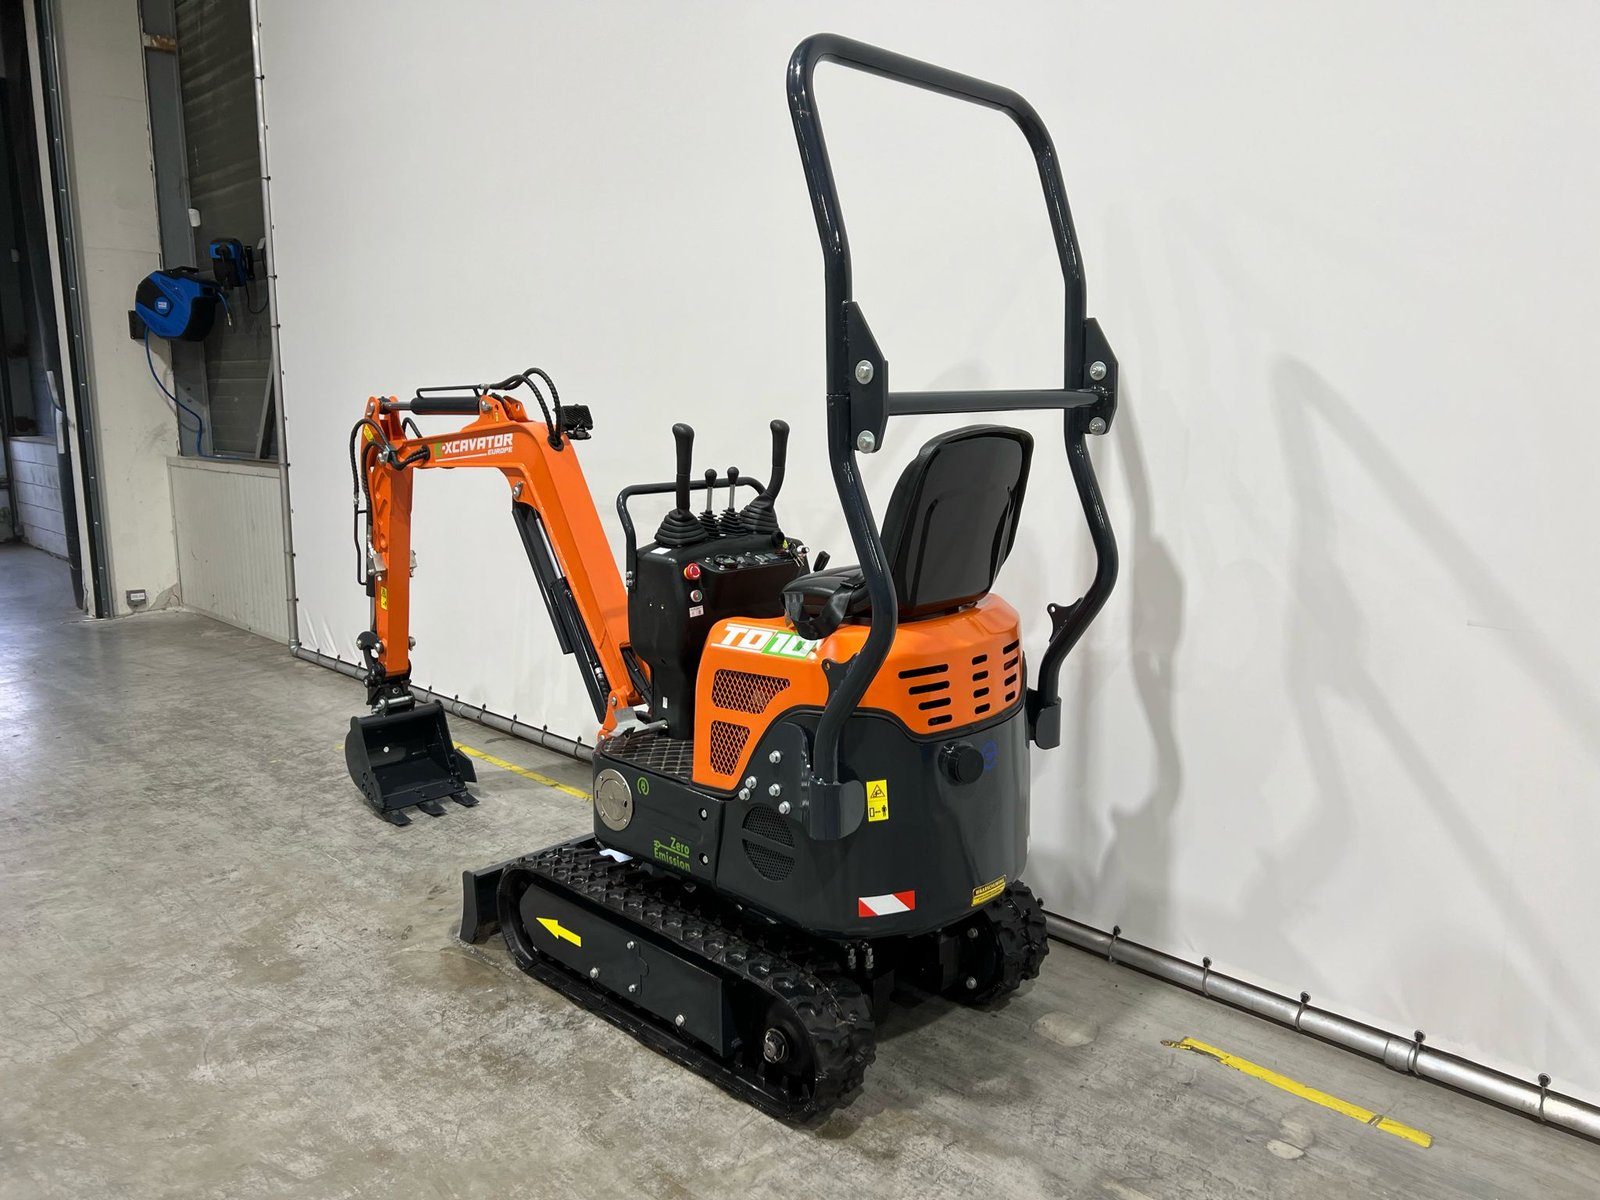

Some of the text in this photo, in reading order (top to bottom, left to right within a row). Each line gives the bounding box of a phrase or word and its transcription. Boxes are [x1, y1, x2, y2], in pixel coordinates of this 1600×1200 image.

[487, 446, 513, 456] EUROPE
[670, 836, 690, 855] Zero
[653, 847, 691, 872] Emission
